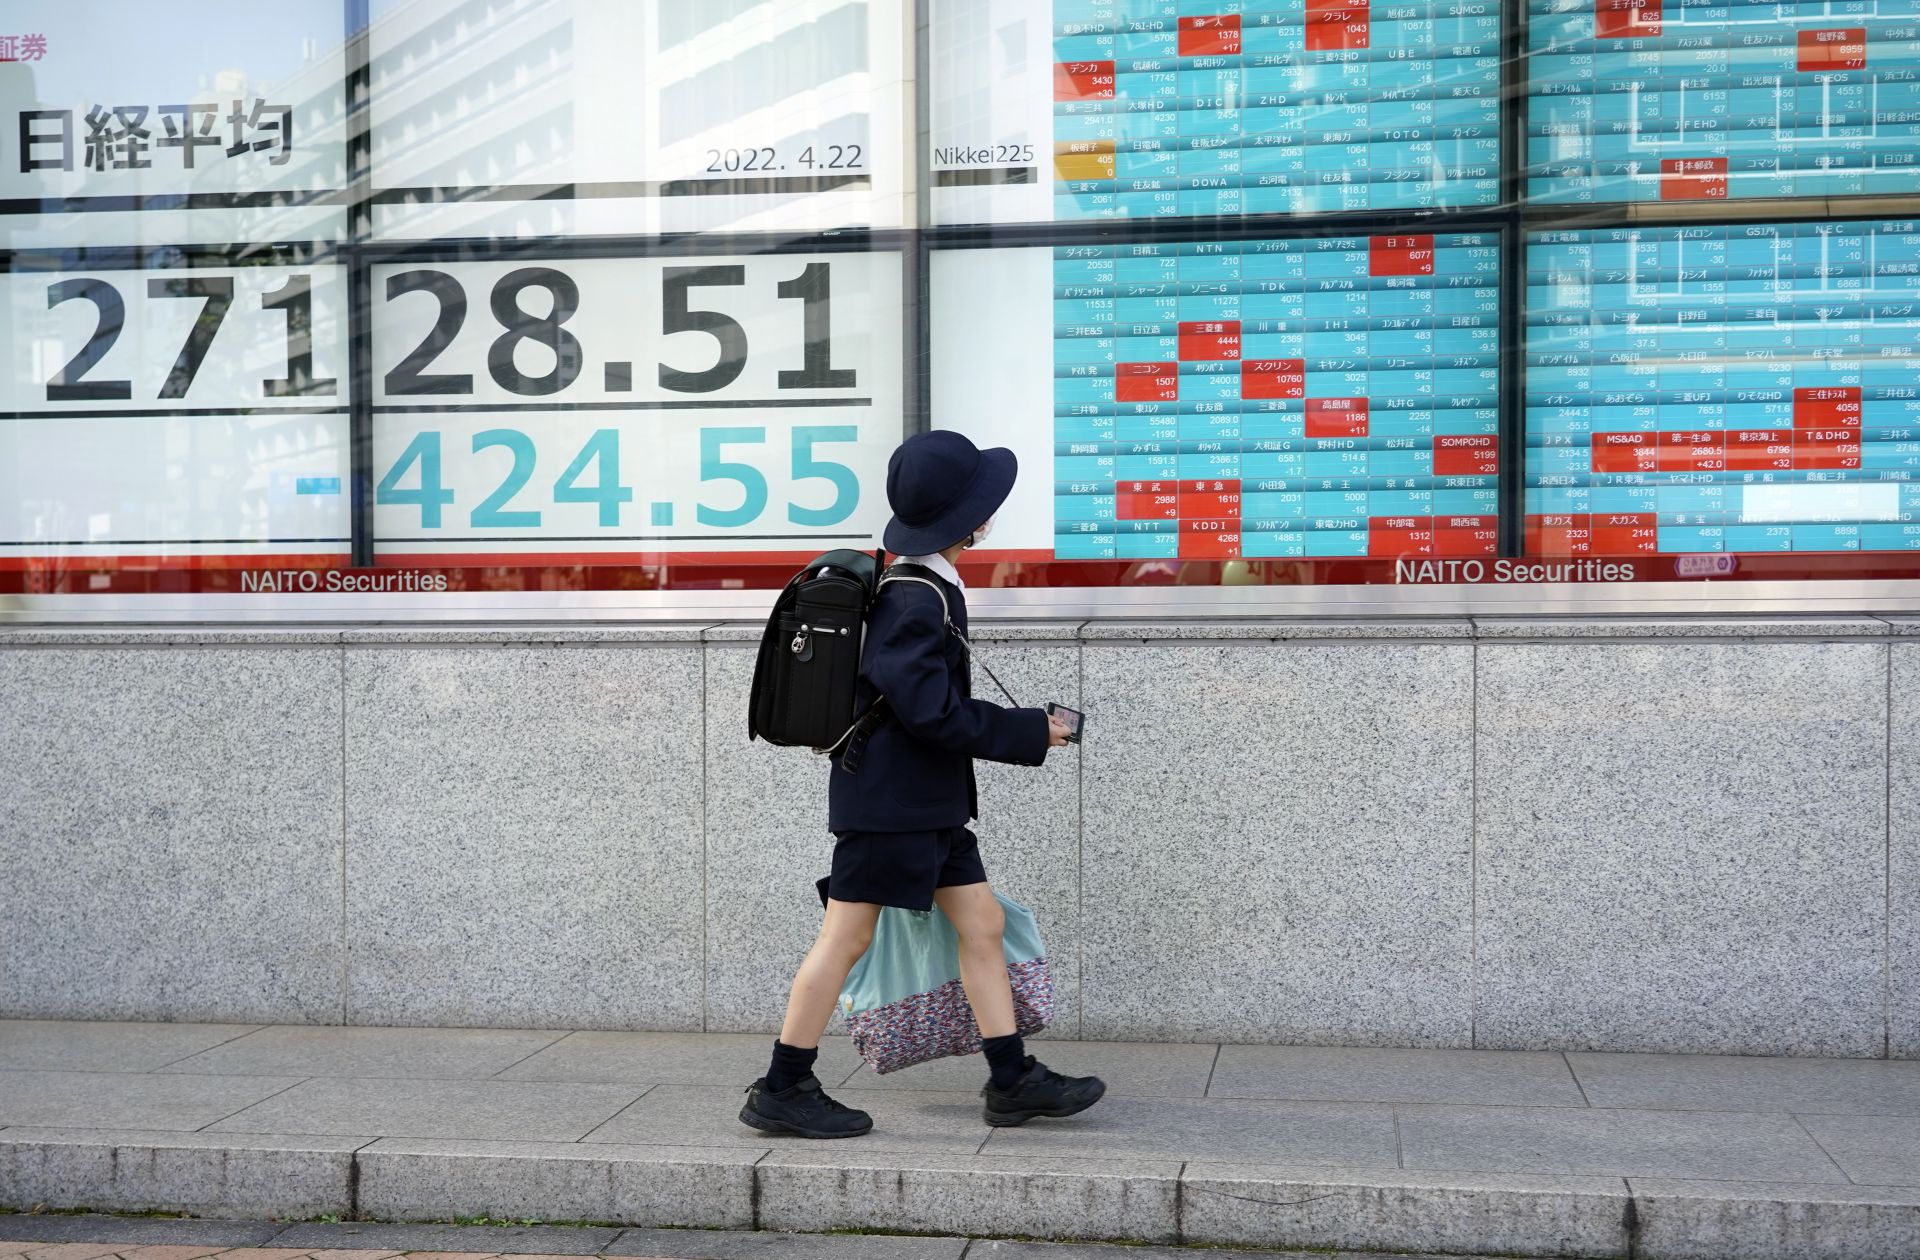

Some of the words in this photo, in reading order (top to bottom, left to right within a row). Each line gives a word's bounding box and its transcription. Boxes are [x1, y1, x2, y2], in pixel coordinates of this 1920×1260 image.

[1387, 8, 1416, 18] 旭化成
[1449, 5, 1485, 14] SUMCO
[1323, 11, 1351, 22] クラレ
[1642, 11, 1659, 20] 625
[1346, 24, 1366, 33] 1043
[1218, 30, 1238, 39] 1378
[1222, 44, 1238, 52] +17
[1452, 45, 1481, 56] 電通G
[1840, 45, 1862, 54] 6959
[1845, 58, 1862, 67] +77
[1092, 76, 1112, 84] 3430
[1096, 89, 1112, 97] +30
[1452, 86, 1481, 96] 楽天G
[20, 98, 292, 172] 日経平均
[1452, 126, 1481, 137] ガイシ
[706, 147, 785, 172] 2022.
[798, 144, 862, 170] 4.22
[934, 144, 1034, 166] Nikkei225
[1097, 155, 1112, 164] 405
[1382, 170, 1420, 180] フジクラ
[1883, 222, 1913, 232] 富士通
[1452, 235, 1480, 245] 三菱電
[1541, 232, 1580, 242] 富士電機
[1066, 247, 1102, 257] ダイキン
[1409, 251, 1431, 259] 6077
[1087, 261, 1112, 269] 20530
[1387, 278, 1415, 288] 横河電
[1128, 285, 1165, 295] シャープ
[1191, 283, 1228, 293] ソニーG
[1882, 305, 1912, 315] ホンダ
[1452, 316, 1480, 326] 日産自
[1066, 326, 1102, 336] 三井E&S
[1133, 325, 1160, 334] 日立造
[1195, 323, 1223, 333] 三菱重
[1217, 336, 1238, 345] 4444
[1222, 349, 1238, 358] +38
[1677, 351, 1707, 361] 大日印
[1745, 350, 1774, 360] ヤマハ
[1813, 348, 1843, 358] 任天堂
[1254, 361, 1291, 371] スクリン
[1387, 358, 1415, 368] リコー
[1133, 364, 1160, 374] ニコン
[1155, 378, 1175, 386] 1507
[1276, 375, 1302, 383] 10760
[1345, 373, 1366, 382] 3025
[1159, 390, 1175, 398] +13
[1286, 388, 1302, 396] +50
[1737, 391, 1781, 401] りそなHD
[1876, 388, 1916, 398] 三井住友
[1544, 395, 1573, 404] イオン
[1605, 394, 1644, 403] あおぞら
[1673, 392, 1710, 402] 三菱UFJ
[1195, 402, 1223, 412] 住友商
[1259, 401, 1286, 411] 三菱商
[1322, 400, 1350, 409] 高島屋
[1387, 398, 1415, 408] 丸井G
[1836, 403, 1858, 412] 4058
[1071, 405, 1098, 414] 三井物
[1150, 417, 1175, 425] 55480
[1345, 413, 1366, 422] 1186
[1841, 417, 1858, 425] +25
[1350, 426, 1365, 434] +11
[1880, 429, 1911, 439] 三井不
[1606, 434, 1642, 443] MS&AD
[1672, 433, 1711, 443] 第一生命
[1739, 432, 1779, 442] 東京海上
[1254, 441, 1291, 450] 大和証G
[1318, 440, 1355, 449] 野村HD
[1387, 438, 1415, 448] 松井証
[1441, 438, 1490, 446] SOMPOHD
[1133, 443, 1160, 452] みずほ
[1633, 448, 1655, 456] 3844
[1692, 447, 1722, 455] 2680.5
[1767, 446, 1790, 454] 6796
[1836, 444, 1858, 453] 1725
[1474, 451, 1496, 459] 5199
[1638, 461, 1655, 469] +34
[1697, 460, 1722, 468] +42.0
[1772, 459, 1790, 467] +32
[1841, 458, 1858, 466] +27
[1479, 464, 1496, 472] +20
[1445, 477, 1485, 487] JR東日本
[1537, 475, 1578, 484] JR西日本
[1669, 474, 1713, 483] ヤマトHD
[1071, 483, 1098, 492] 住友不
[1259, 480, 1286, 490] 小田急
[1155, 496, 1175, 504] 2988
[1218, 495, 1238, 503] 1610
[1344, 493, 1366, 501] 5000
[1314, 519, 1357, 528] 東電力HD
[1386, 518, 1415, 528] 中部電
[1451, 517, 1480, 527] 関西電
[1543, 515, 1572, 524] 東ガス
[1609, 515, 1638, 524] 大ガス
[1410, 532, 1430, 540] 1312
[1475, 531, 1496, 539] 1210
[1632, 528, 1653, 536] 2141
[1217, 534, 1238, 542] 4268
[1637, 541, 1654, 549] +14
[1397, 560, 1484, 583] NAITO
[1494, 559, 1635, 583] Securities
[241, 570, 317, 592] NAITO
[326, 570, 448, 592] Securities
